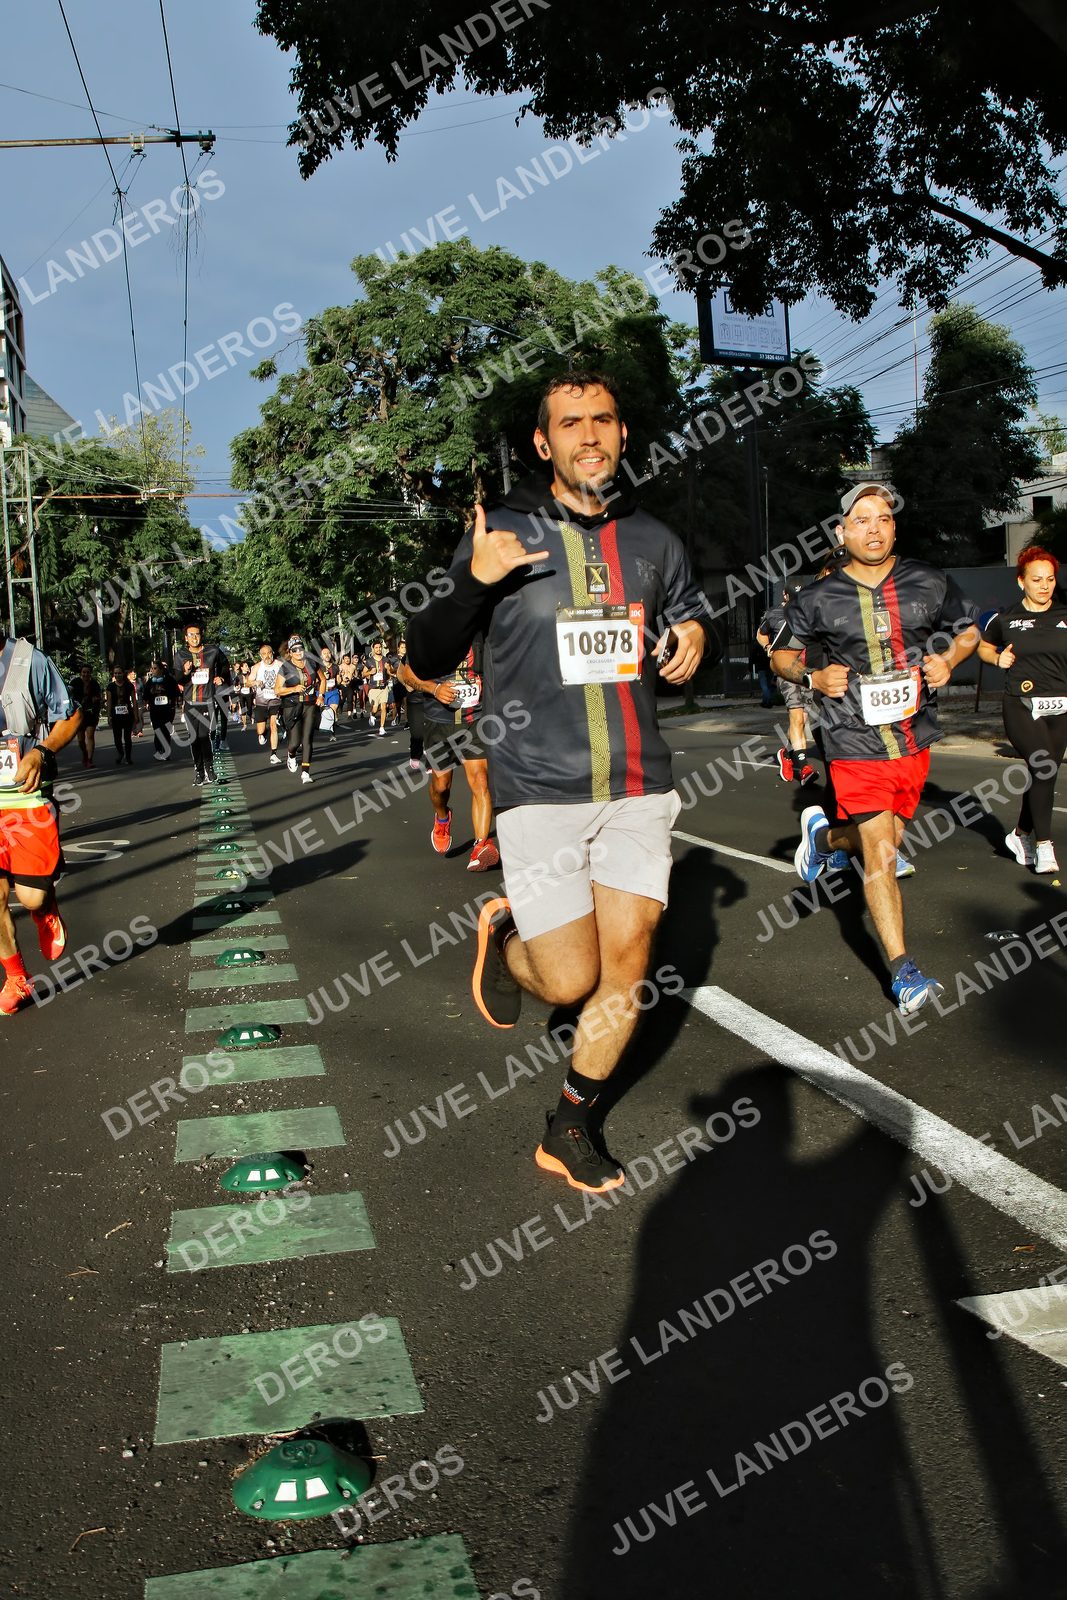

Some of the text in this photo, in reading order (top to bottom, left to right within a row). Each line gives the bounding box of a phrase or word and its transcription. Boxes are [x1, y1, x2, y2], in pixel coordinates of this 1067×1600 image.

[563, 629, 633, 656] 10878
[870, 685, 910, 707] 8835
[1038, 700, 1063, 710] 8355
